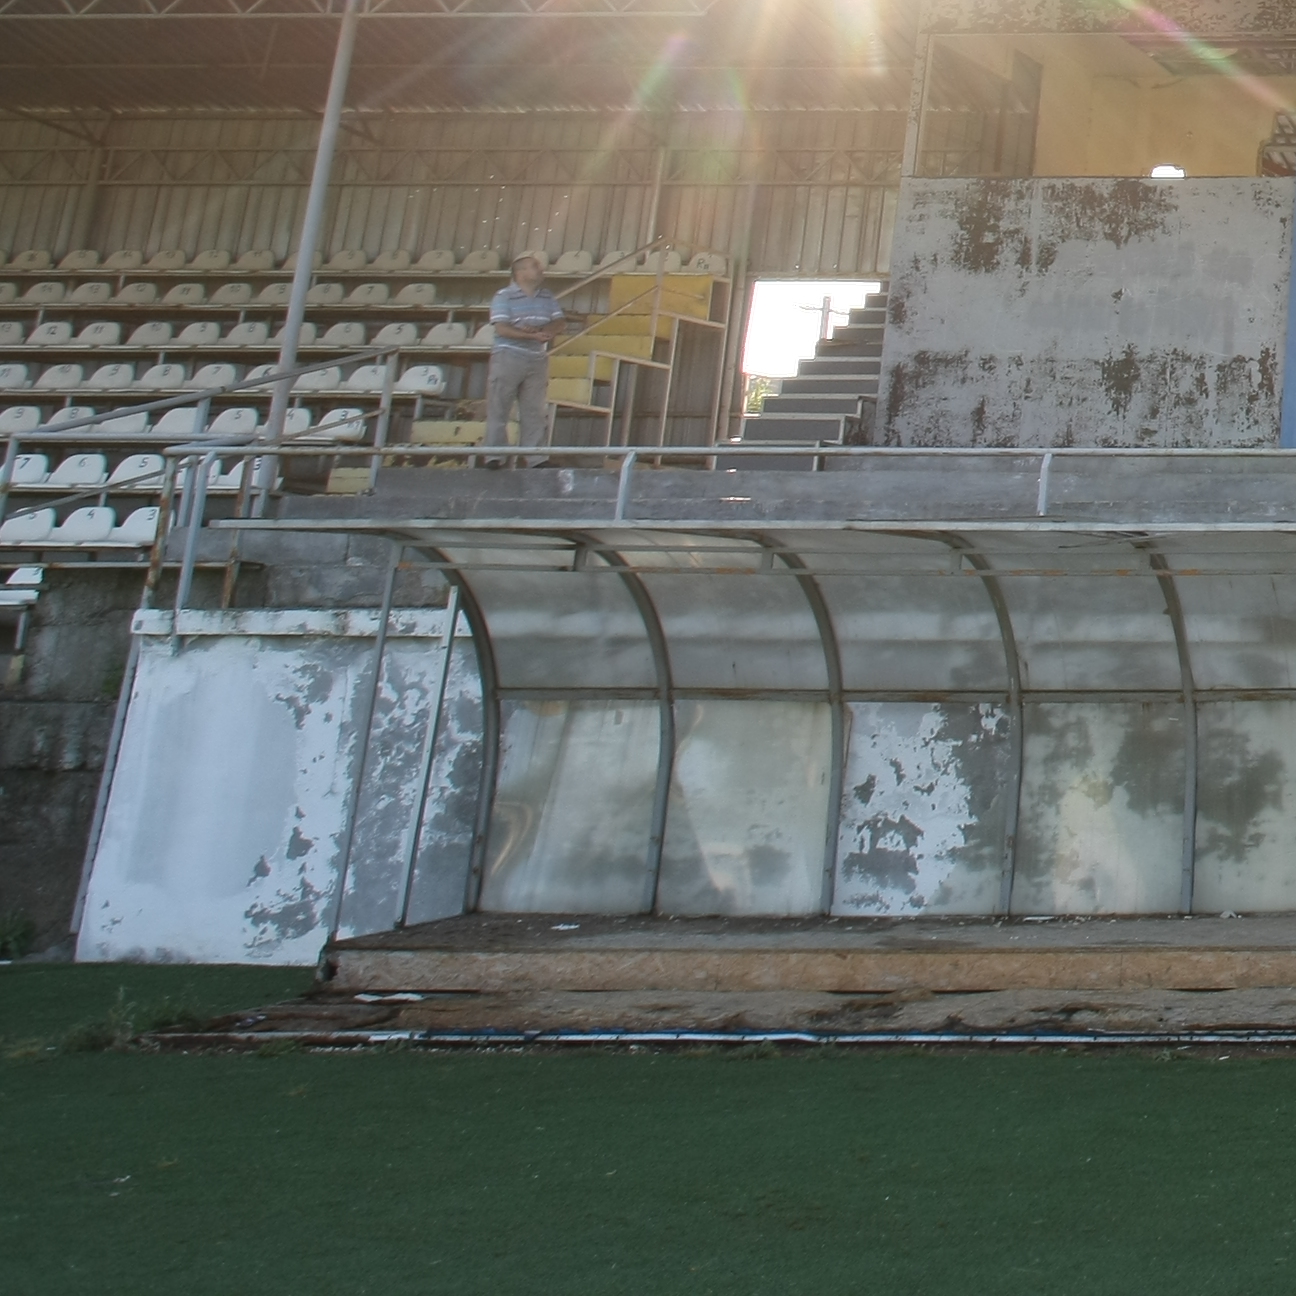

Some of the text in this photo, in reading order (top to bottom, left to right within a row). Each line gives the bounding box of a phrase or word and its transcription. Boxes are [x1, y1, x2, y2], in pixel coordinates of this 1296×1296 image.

[367, 285, 375, 295] 7
[46, 325, 58, 335] 12
[14, 407, 25, 419] 9
[70, 407, 80, 420] 8
[234, 409, 244, 420] 5
[19, 457, 31, 470] 7
[78, 457, 88, 468] 6
[138, 457, 149, 468] 5
[87, 509, 95, 520] 4
[147, 509, 158, 521] 3
